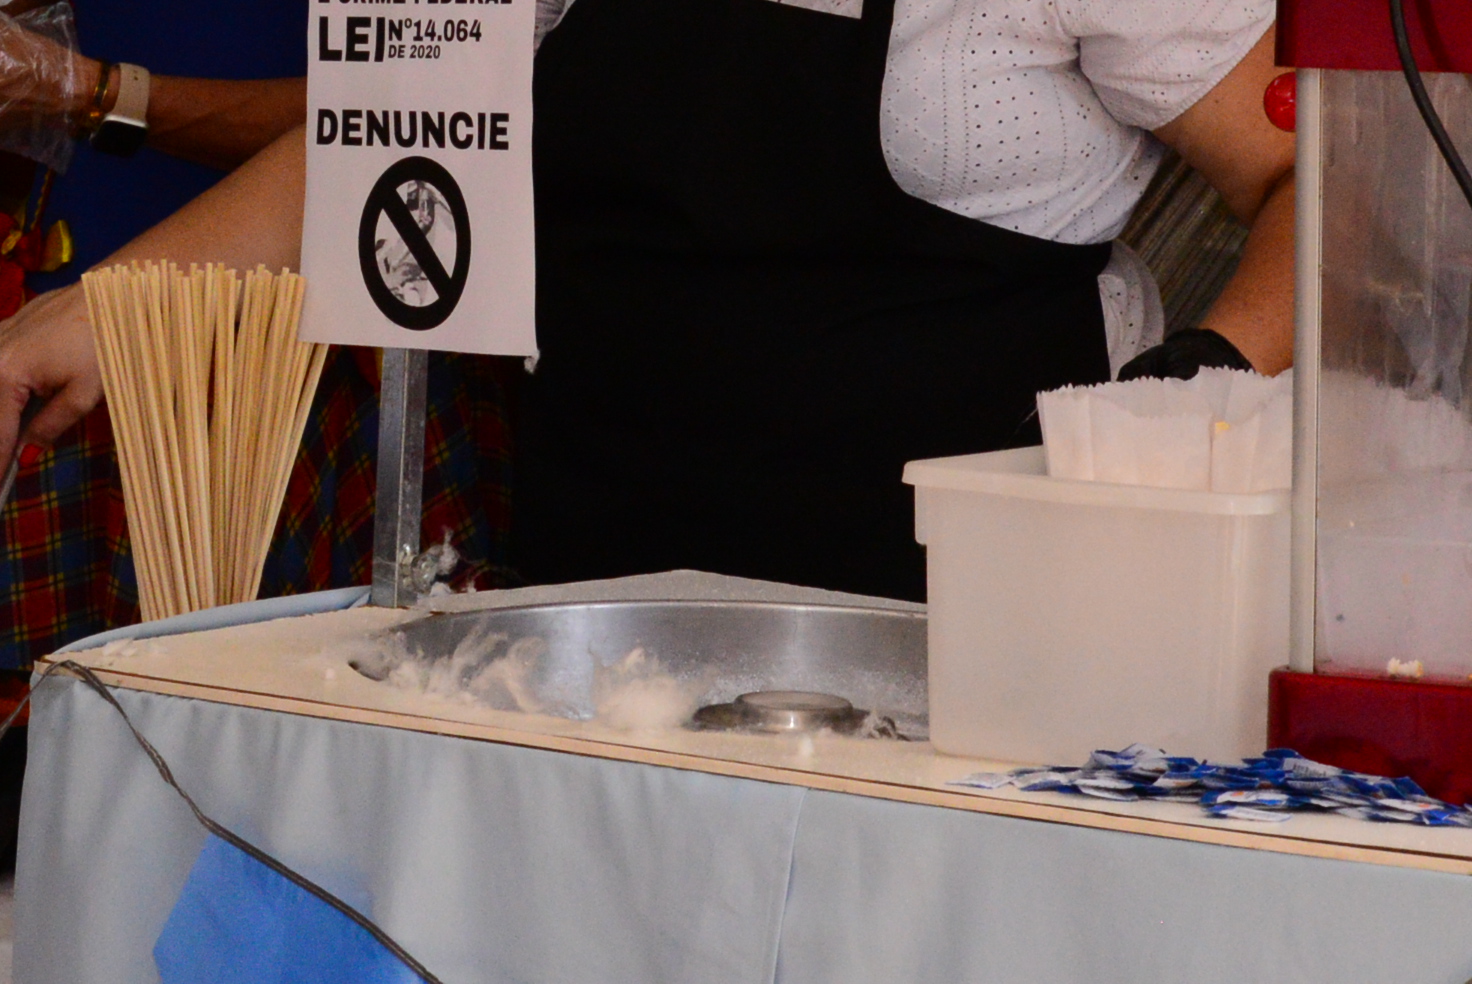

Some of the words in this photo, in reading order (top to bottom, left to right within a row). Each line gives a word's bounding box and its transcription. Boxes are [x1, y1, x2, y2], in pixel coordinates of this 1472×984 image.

[318, 16, 386, 62] LEI
[388, 44, 405, 59] DE
[409, 44, 441, 59] 2020
[316, 108, 510, 150] DENUNCIE
